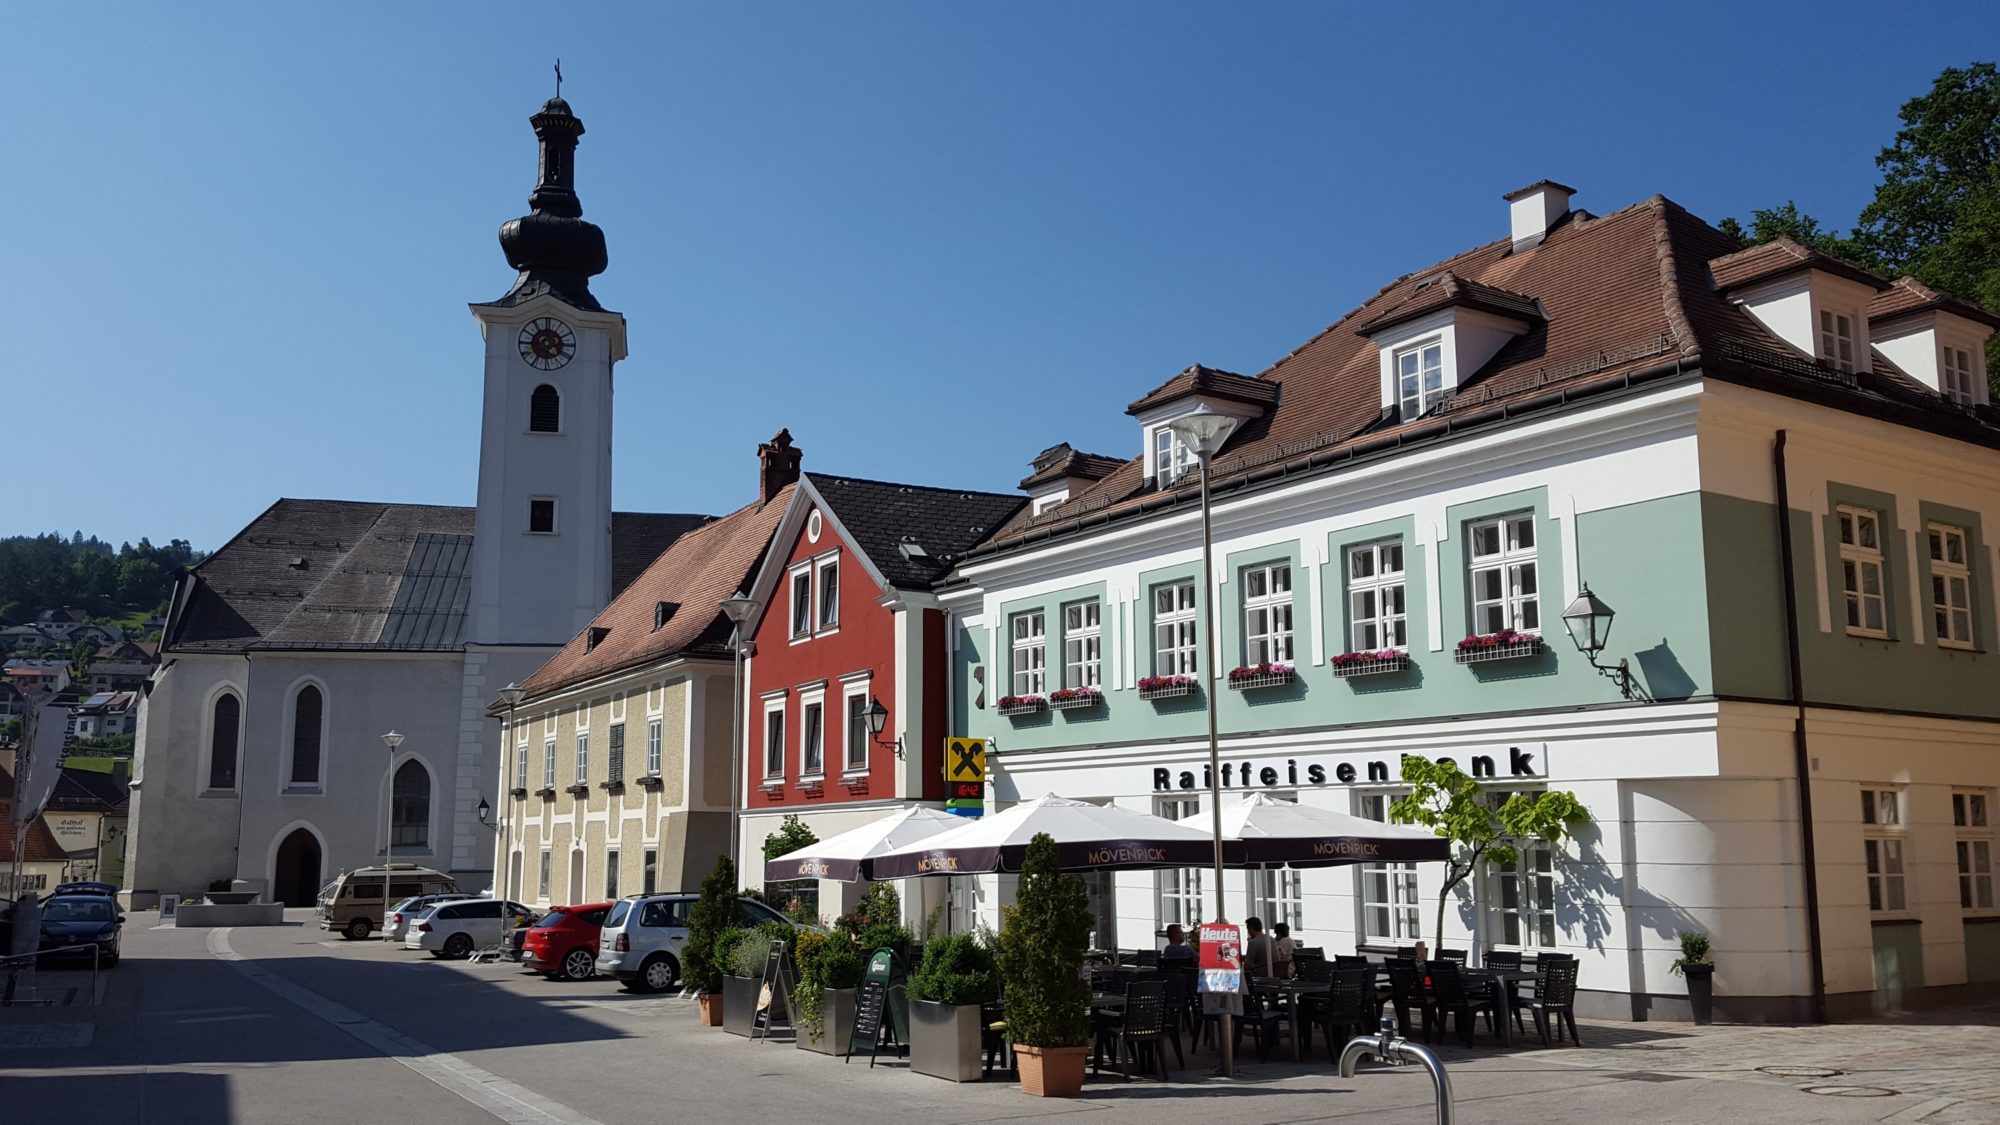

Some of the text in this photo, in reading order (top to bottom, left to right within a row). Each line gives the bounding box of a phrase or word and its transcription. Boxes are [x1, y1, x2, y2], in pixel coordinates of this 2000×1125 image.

[1153, 747, 1535, 790] Raiffeisennk
[1088, 848, 1166, 864] MÖVENPICK
[1312, 840, 1379, 856] MÖVENPICK
[918, 856, 958, 872] MÖVENPICK
[1201, 928, 1238, 941] Heute
